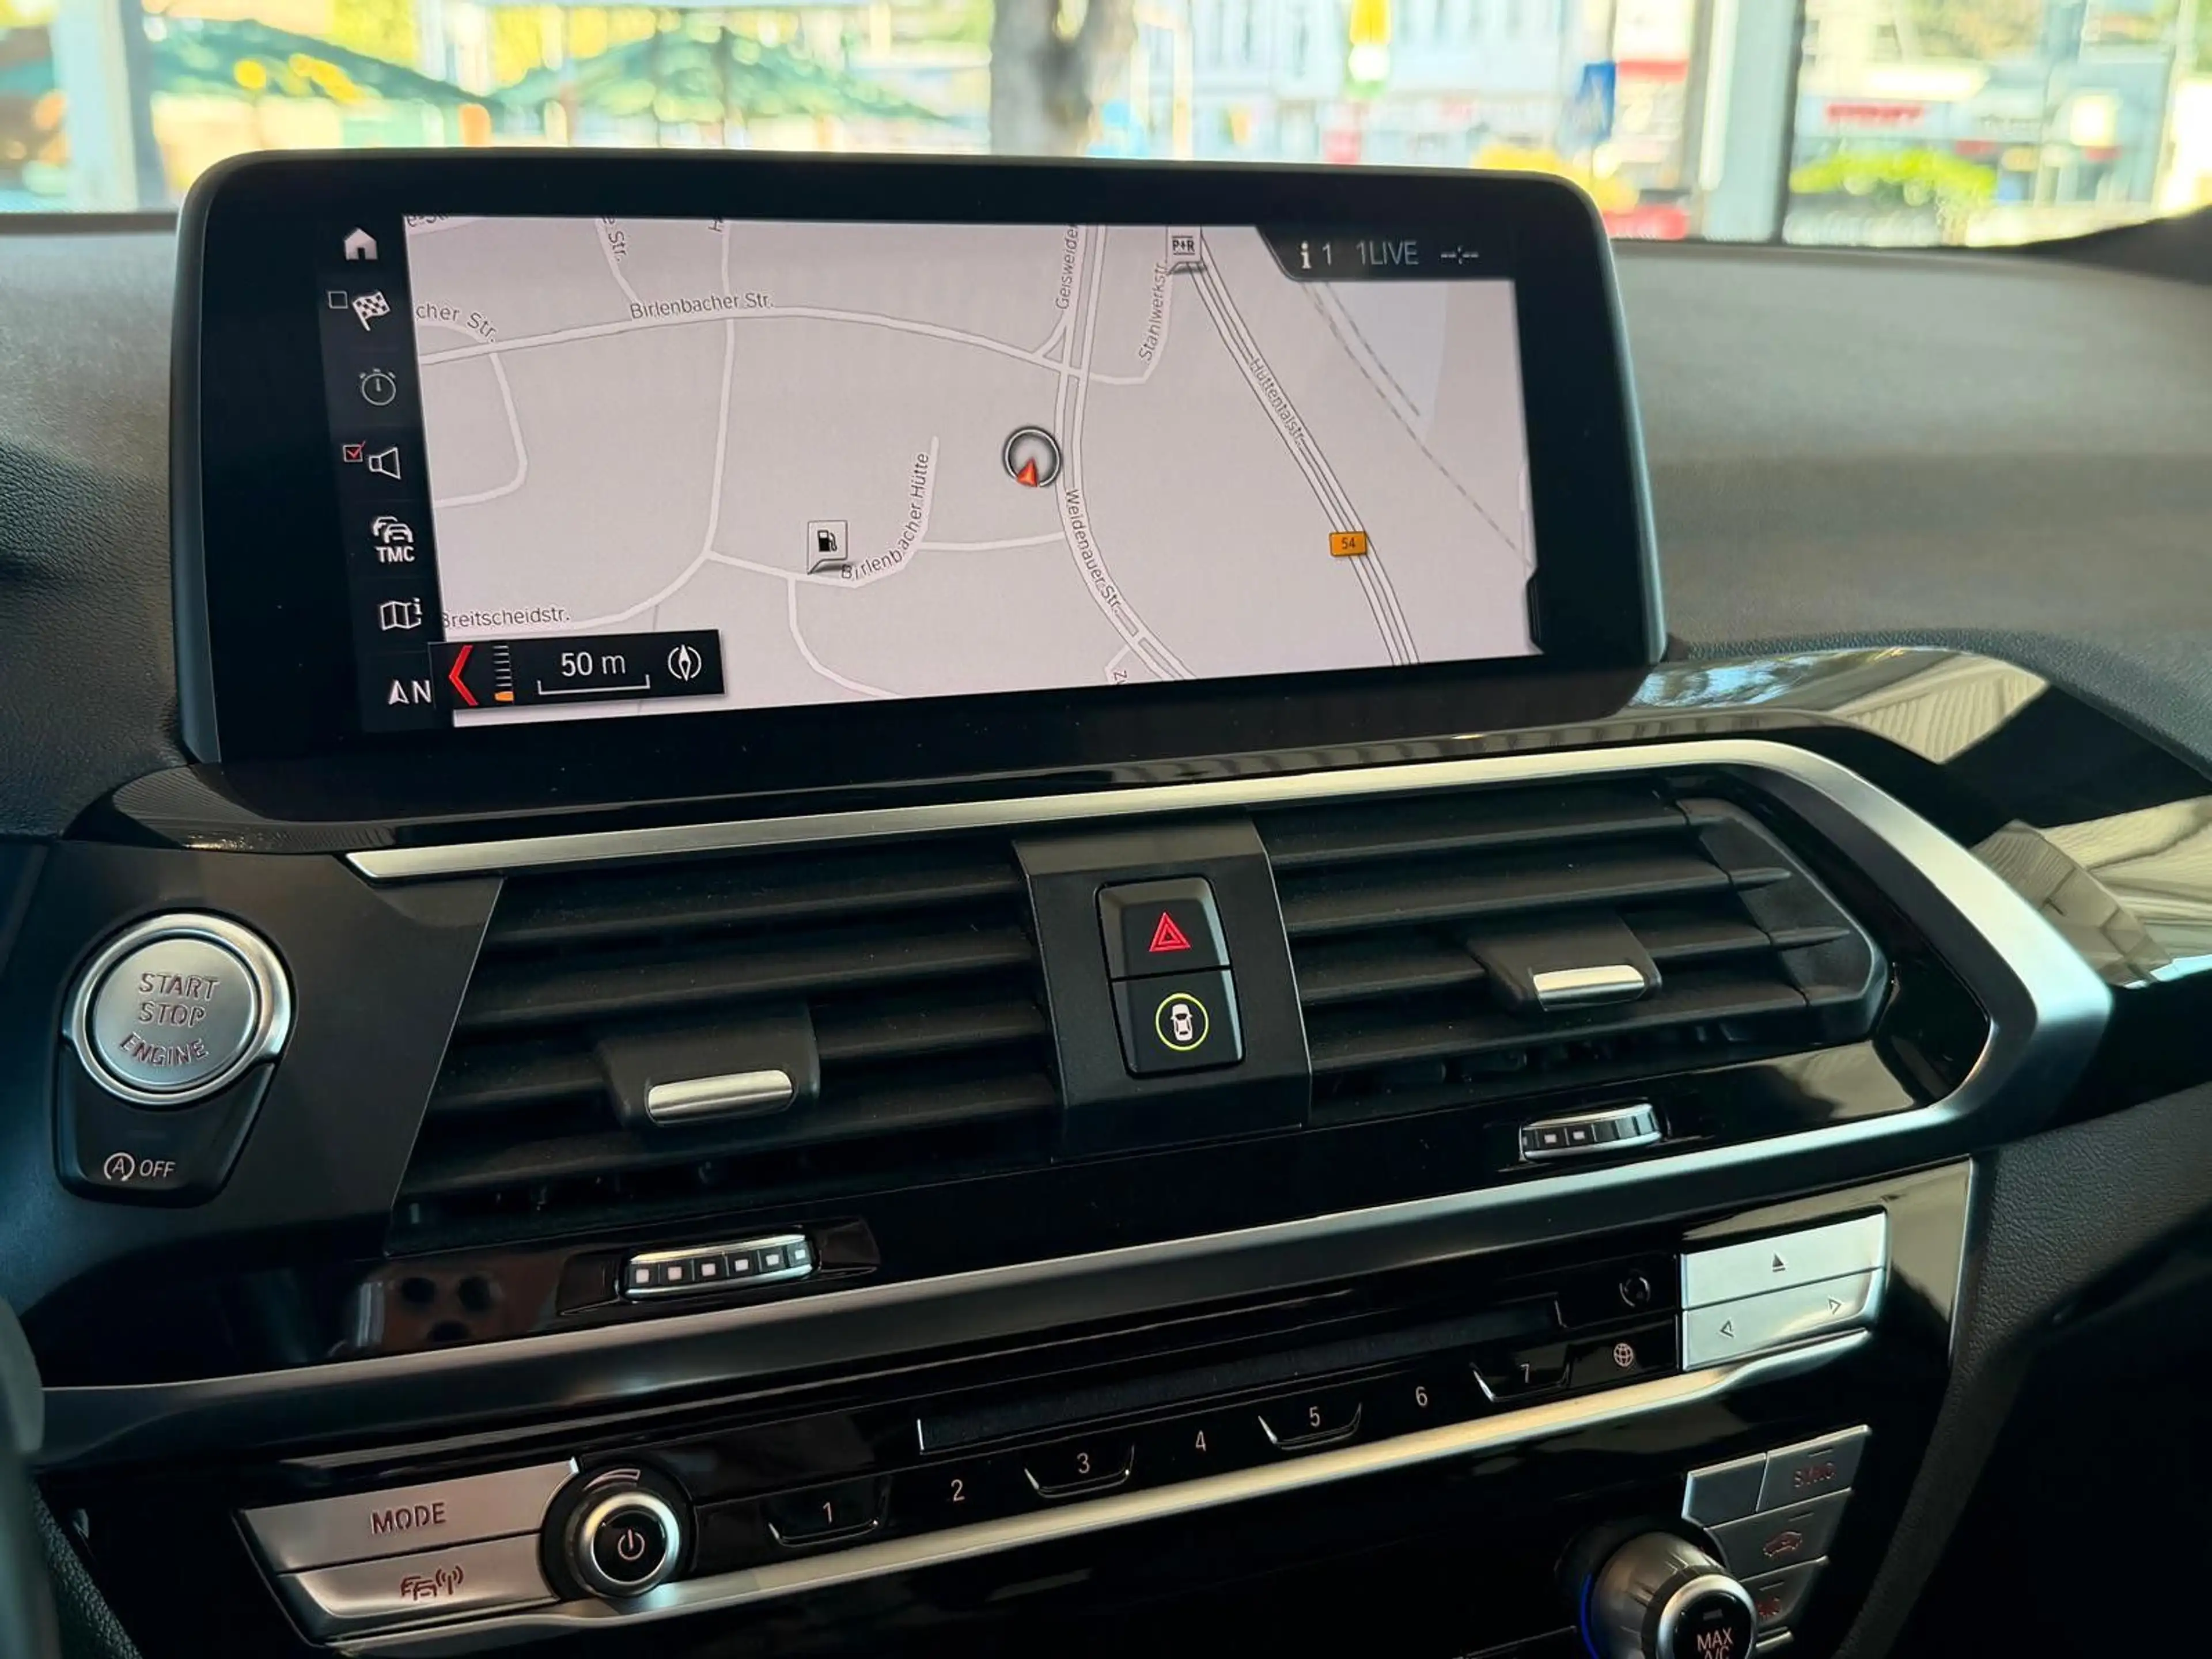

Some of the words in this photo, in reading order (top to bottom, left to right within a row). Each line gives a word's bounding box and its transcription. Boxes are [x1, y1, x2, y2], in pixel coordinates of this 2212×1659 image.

[608, 230, 627, 262] Str.
[1172, 238, 1195, 252] P+R
[1322, 241, 1332, 266] 1
[1356, 240, 1419, 266] 1LIVE
[630, 294, 740, 319] Birlenbacher
[745, 293, 774, 309] Str.
[416, 303, 460, 321] cher
[467, 312, 496, 342] Str.
[841, 502, 922, 580] Birlenbacher
[910, 453, 929, 499] Hütte
[376, 546, 415, 563] TMC
[1065, 488, 1105, 584] Weidenauer
[1101, 585, 1122, 614] Str.
[1341, 536, 1356, 550] 54
[442, 607, 570, 629] Breitscheidstr.
[561, 652, 593, 677] 50
[601, 655, 626, 674] m
[411, 680, 432, 704] N
[138, 972, 219, 1000] START
[138, 1001, 206, 1028] STOP
[119, 1032, 209, 1067] ENGINE
[140, 1158, 176, 1177] OFF
[1520, 1363, 1531, 1383] 7
[1414, 1386, 1428, 1407] 6
[1309, 1406, 1321, 1428] 5
[1195, 1430, 1207, 1453] 4
[1077, 1452, 1090, 1475] 3
[950, 1479, 965, 1503] 2
[370, 1502, 447, 1535] MODE
[822, 1502, 833, 1524] 1
[1696, 1626, 1733, 1652] MAX
